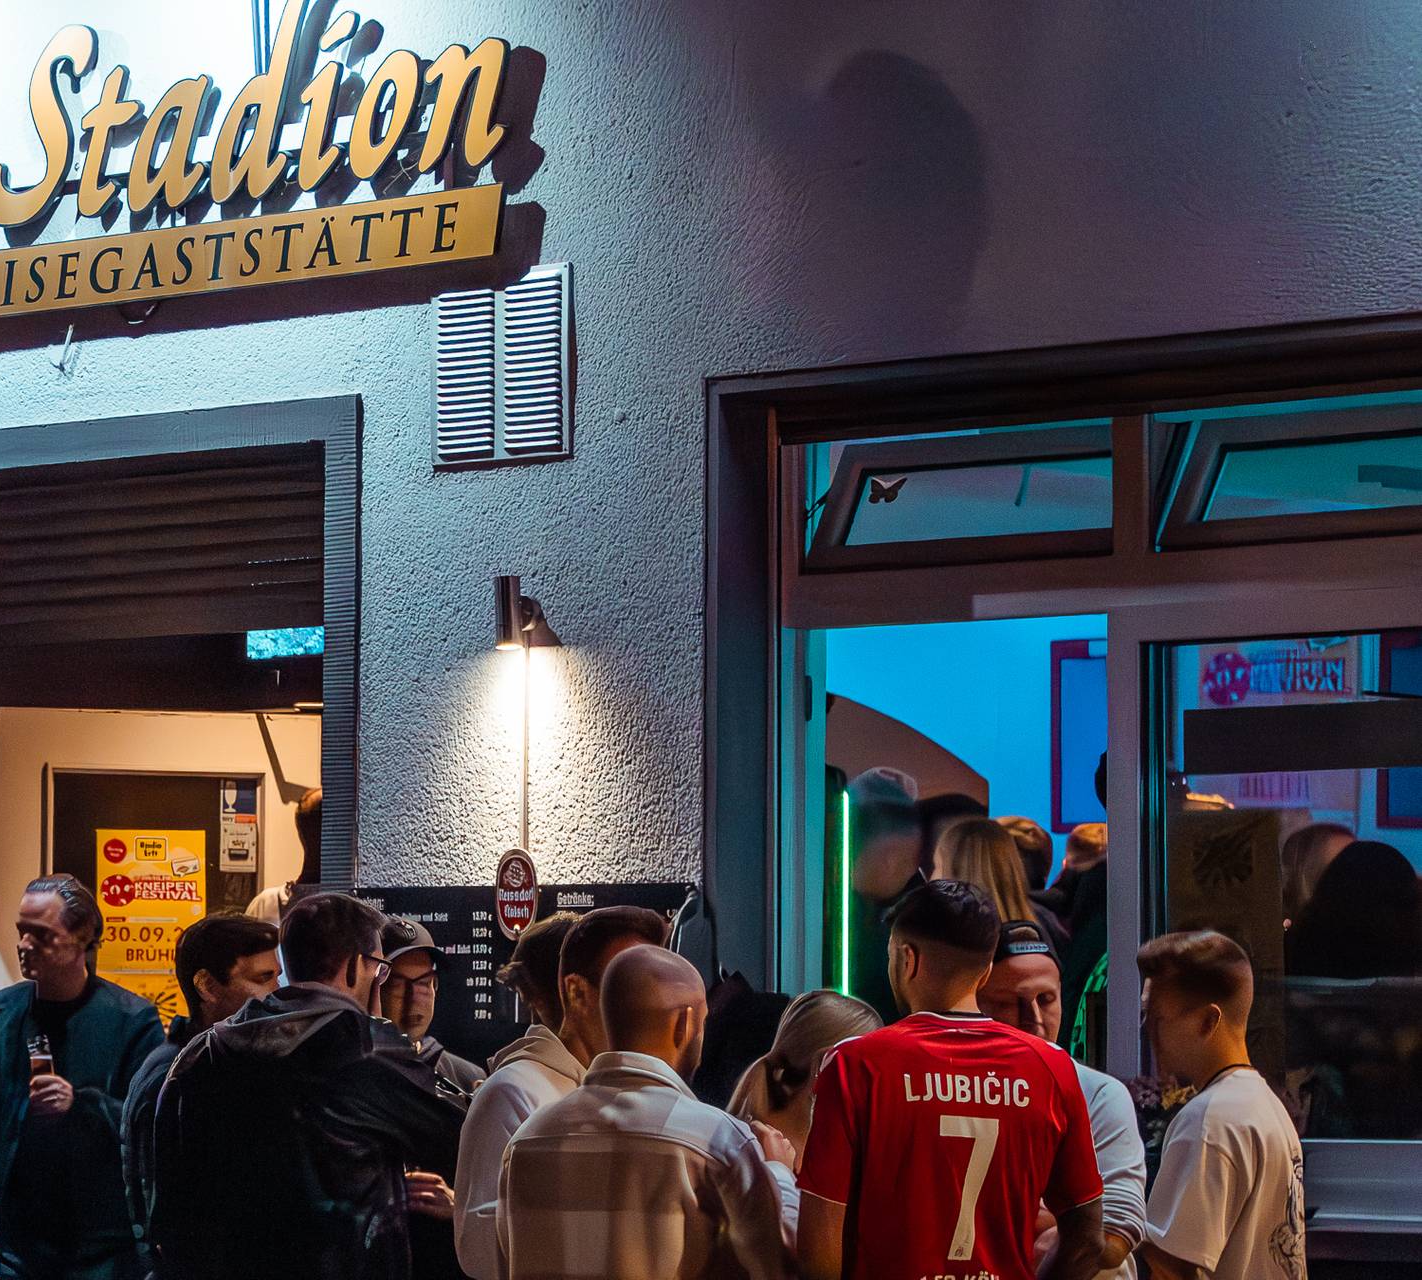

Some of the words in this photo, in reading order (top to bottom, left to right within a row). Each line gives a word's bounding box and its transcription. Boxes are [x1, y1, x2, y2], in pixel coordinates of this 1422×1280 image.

[134, 881, 197, 891] KNEIPEN
[134, 890, 202, 901] FESTIVAL
[903, 1071, 1031, 1108] LJUBIČIC
[939, 1114, 1000, 1261] 7
